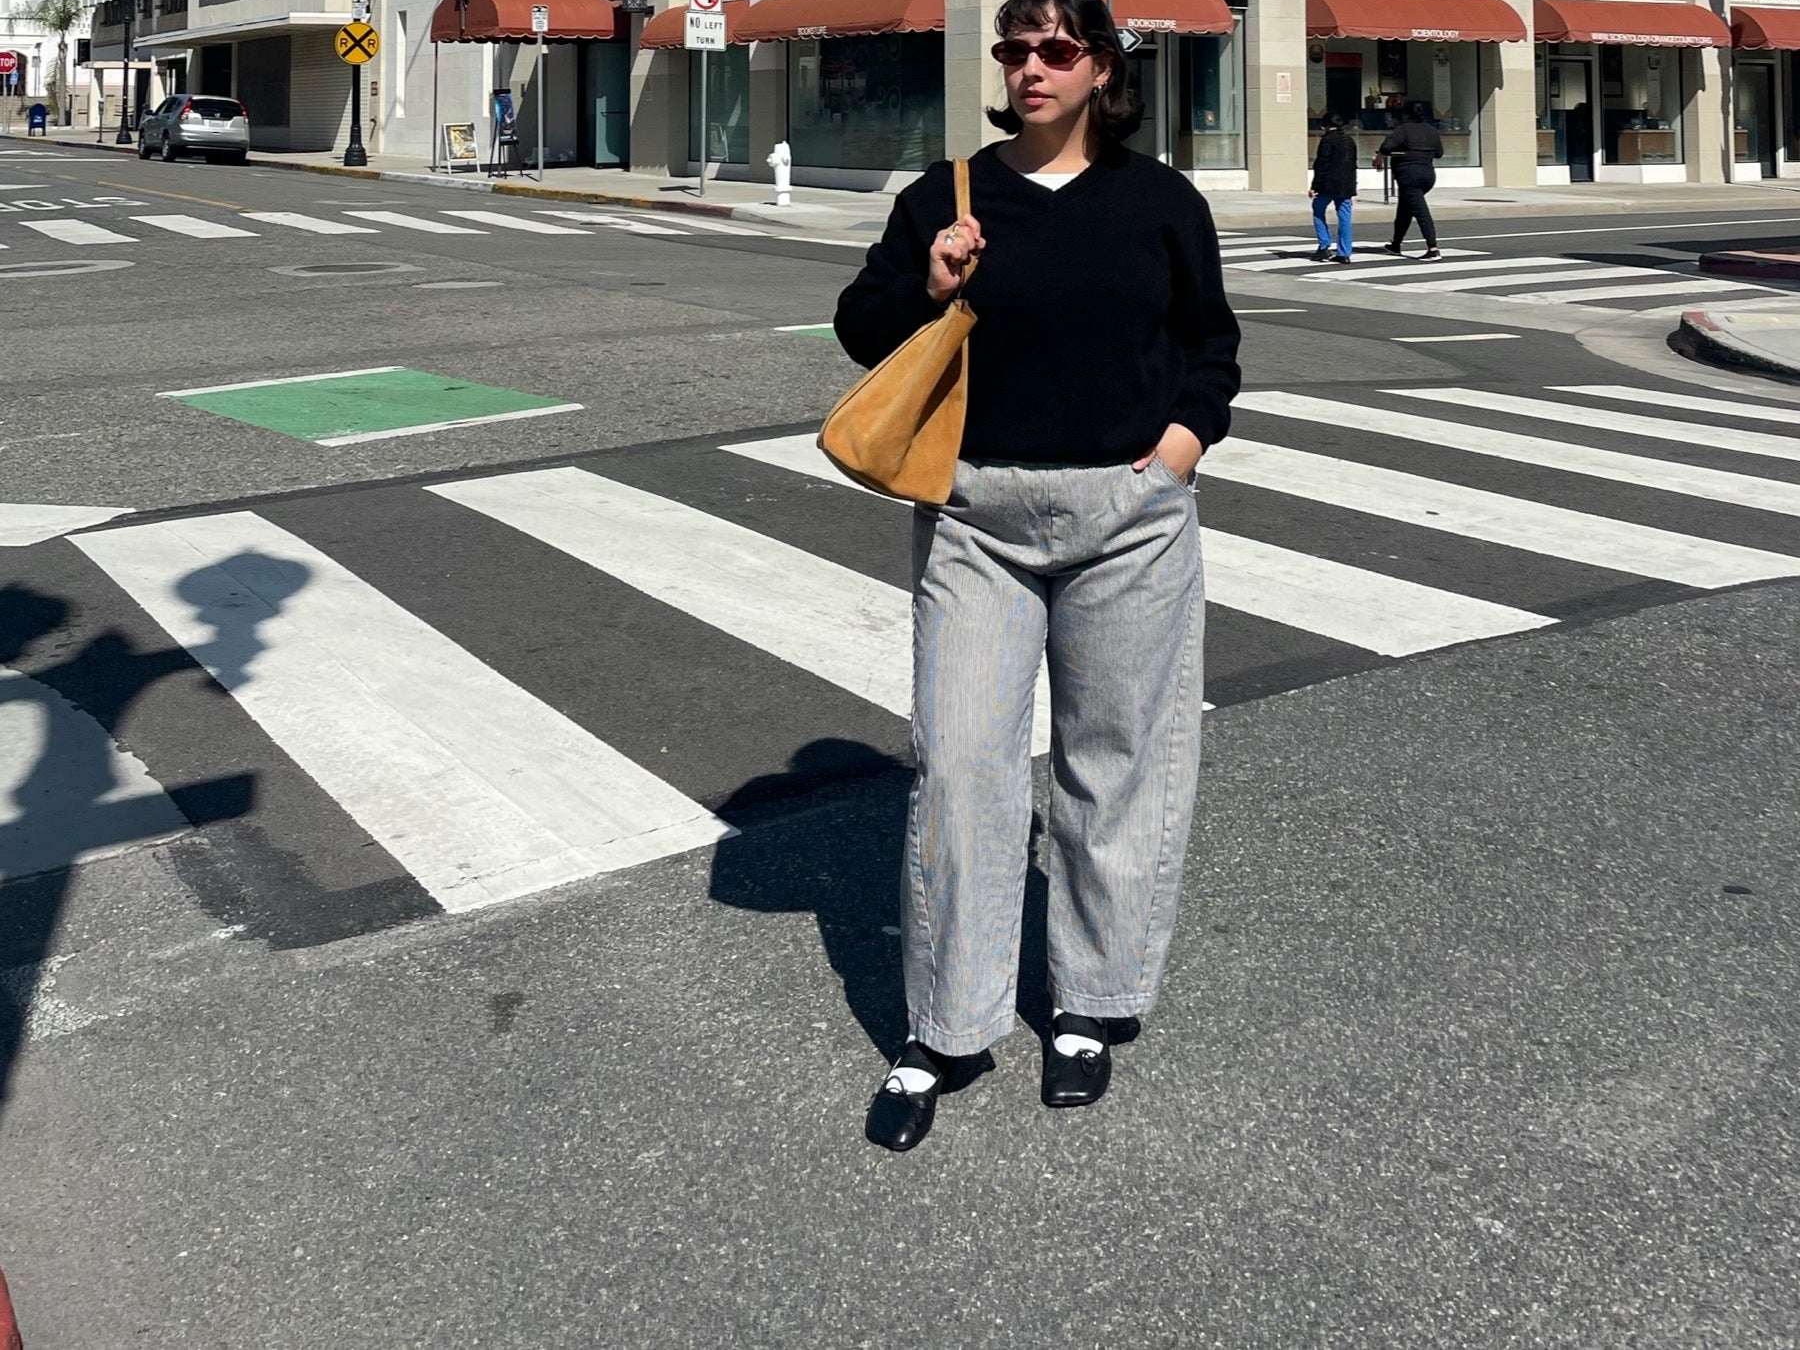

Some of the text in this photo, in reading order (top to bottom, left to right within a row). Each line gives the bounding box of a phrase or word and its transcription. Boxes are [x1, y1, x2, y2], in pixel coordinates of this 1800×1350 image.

[689, 17, 723, 30] NO LEFT
[1127, 18, 1177, 29] BOOKSTORE
[1411, 29, 1460, 38] SCIENTOLOGY
[340, 37, 376, 49] R R
[696, 36, 715, 44] TURN
[0, 57, 15, 68] TOP
